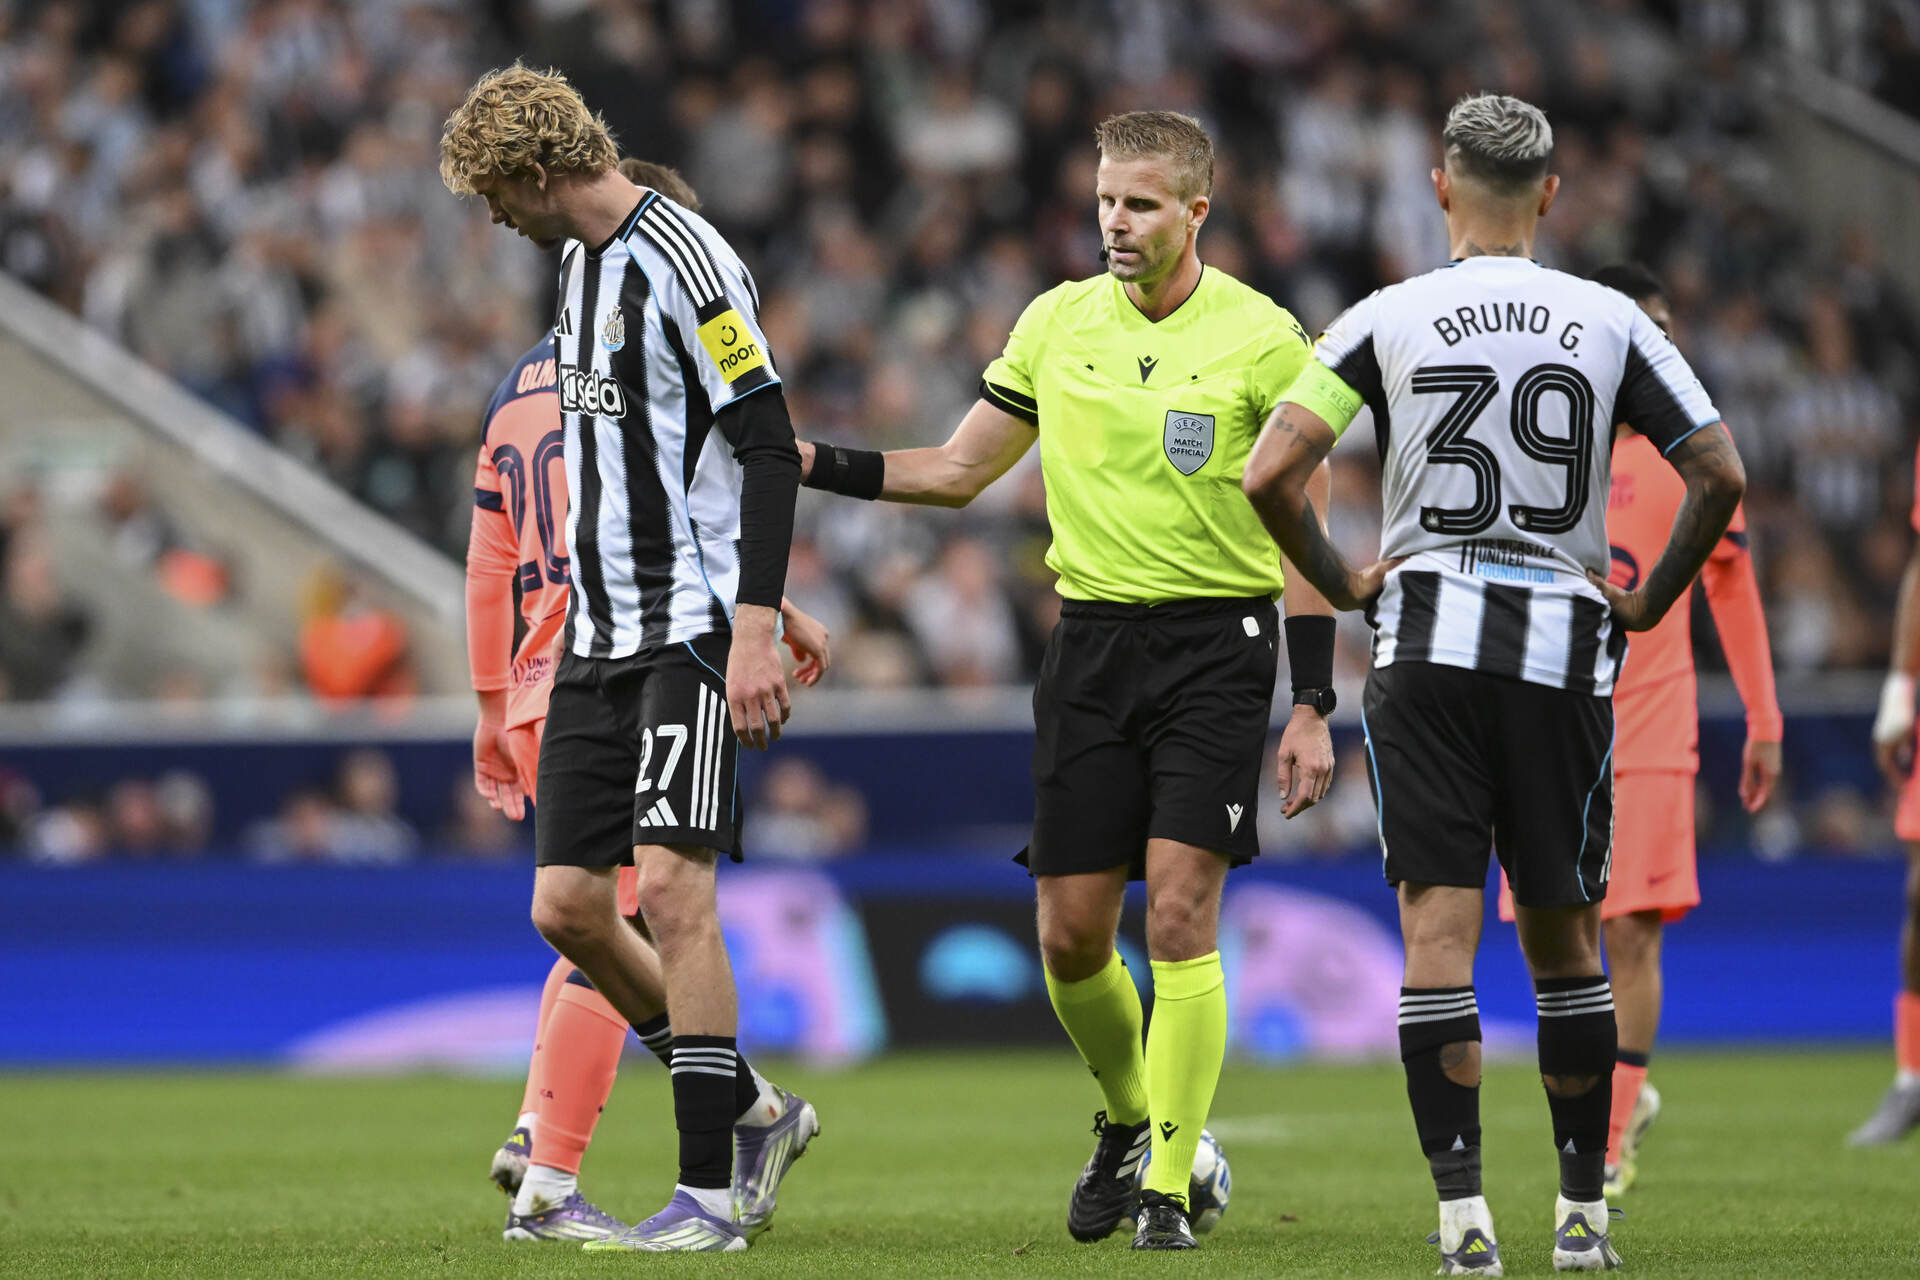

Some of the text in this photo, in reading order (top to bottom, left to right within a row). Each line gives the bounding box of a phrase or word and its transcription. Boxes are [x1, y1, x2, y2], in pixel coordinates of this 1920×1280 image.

[1433, 302, 1584, 358] BRUNO G.
[719, 343, 761, 373] noon
[1174, 419, 1203, 433] UEFA
[1169, 447, 1206, 458] OFFICIAL
[1173, 438, 1203, 447] MATCH
[1411, 362, 1595, 535] 39
[1477, 549, 1525, 567] UNITED
[1476, 562, 1556, 584] FOUNDATION
[634, 723, 688, 794] 27
